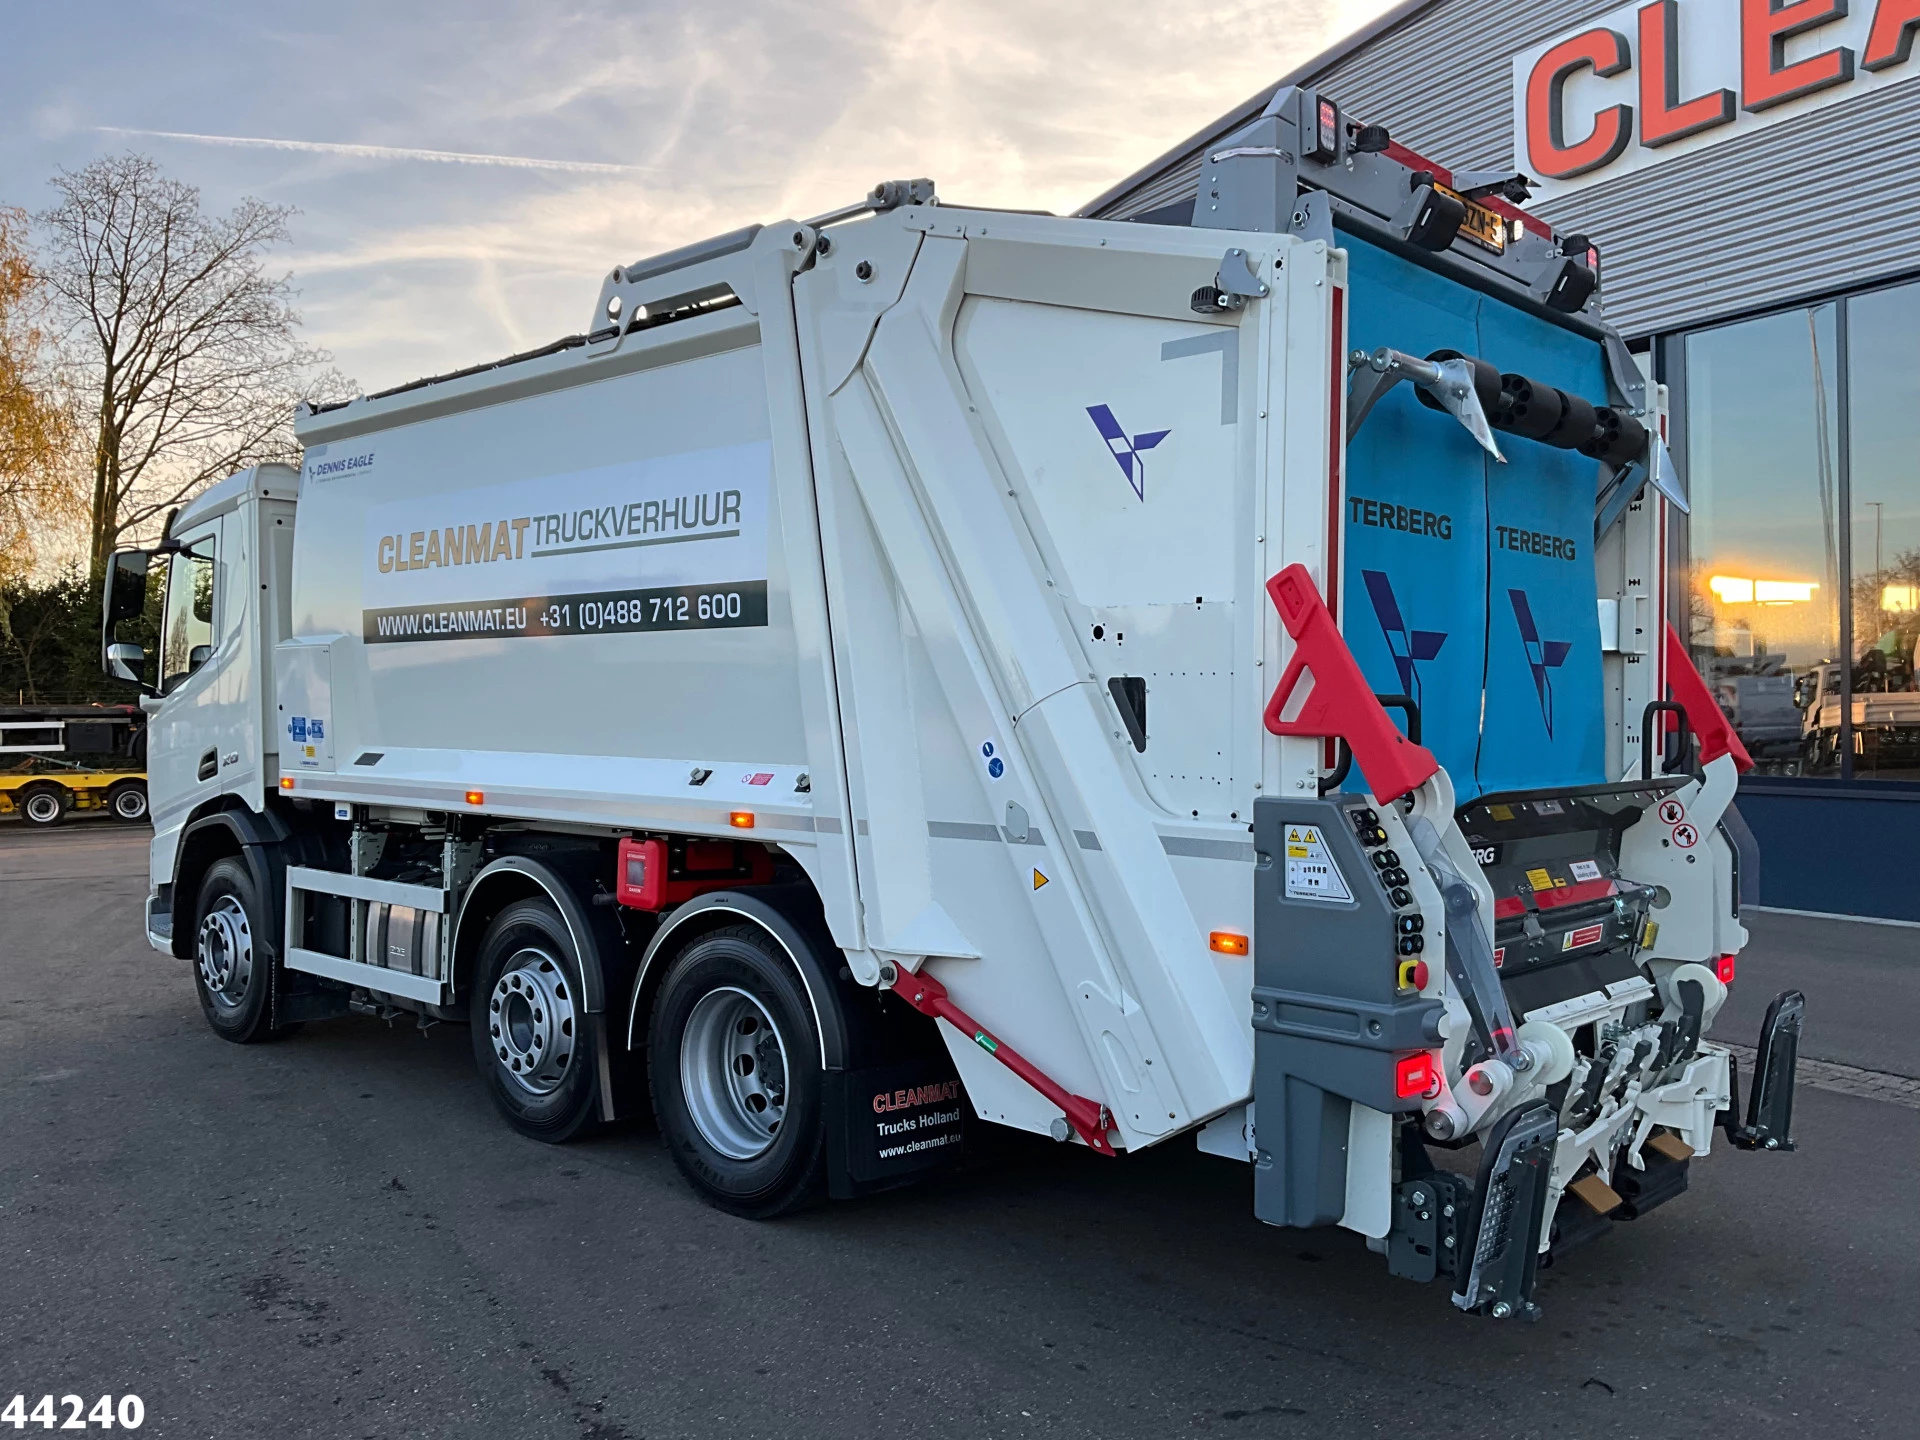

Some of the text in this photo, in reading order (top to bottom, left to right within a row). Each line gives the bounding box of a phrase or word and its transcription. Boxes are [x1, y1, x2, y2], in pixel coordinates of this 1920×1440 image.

[316, 459, 346, 476] DENNIS
[346, 453, 375, 470] EAGLE
[378, 489, 741, 574] CLEANMAT TRUCKVERHUUR
[1349, 496, 1452, 540] TERBERG
[1495, 525, 1576, 561] TERBERG
[377, 592, 741, 637] WWW.CLEANMAT.EU +31 (0)488 712 600
[873, 1080, 960, 1113] CLEANMAT
[876, 1107, 960, 1136] Trucks Holland
[879, 1133, 961, 1158] www.cleanmat.eu
